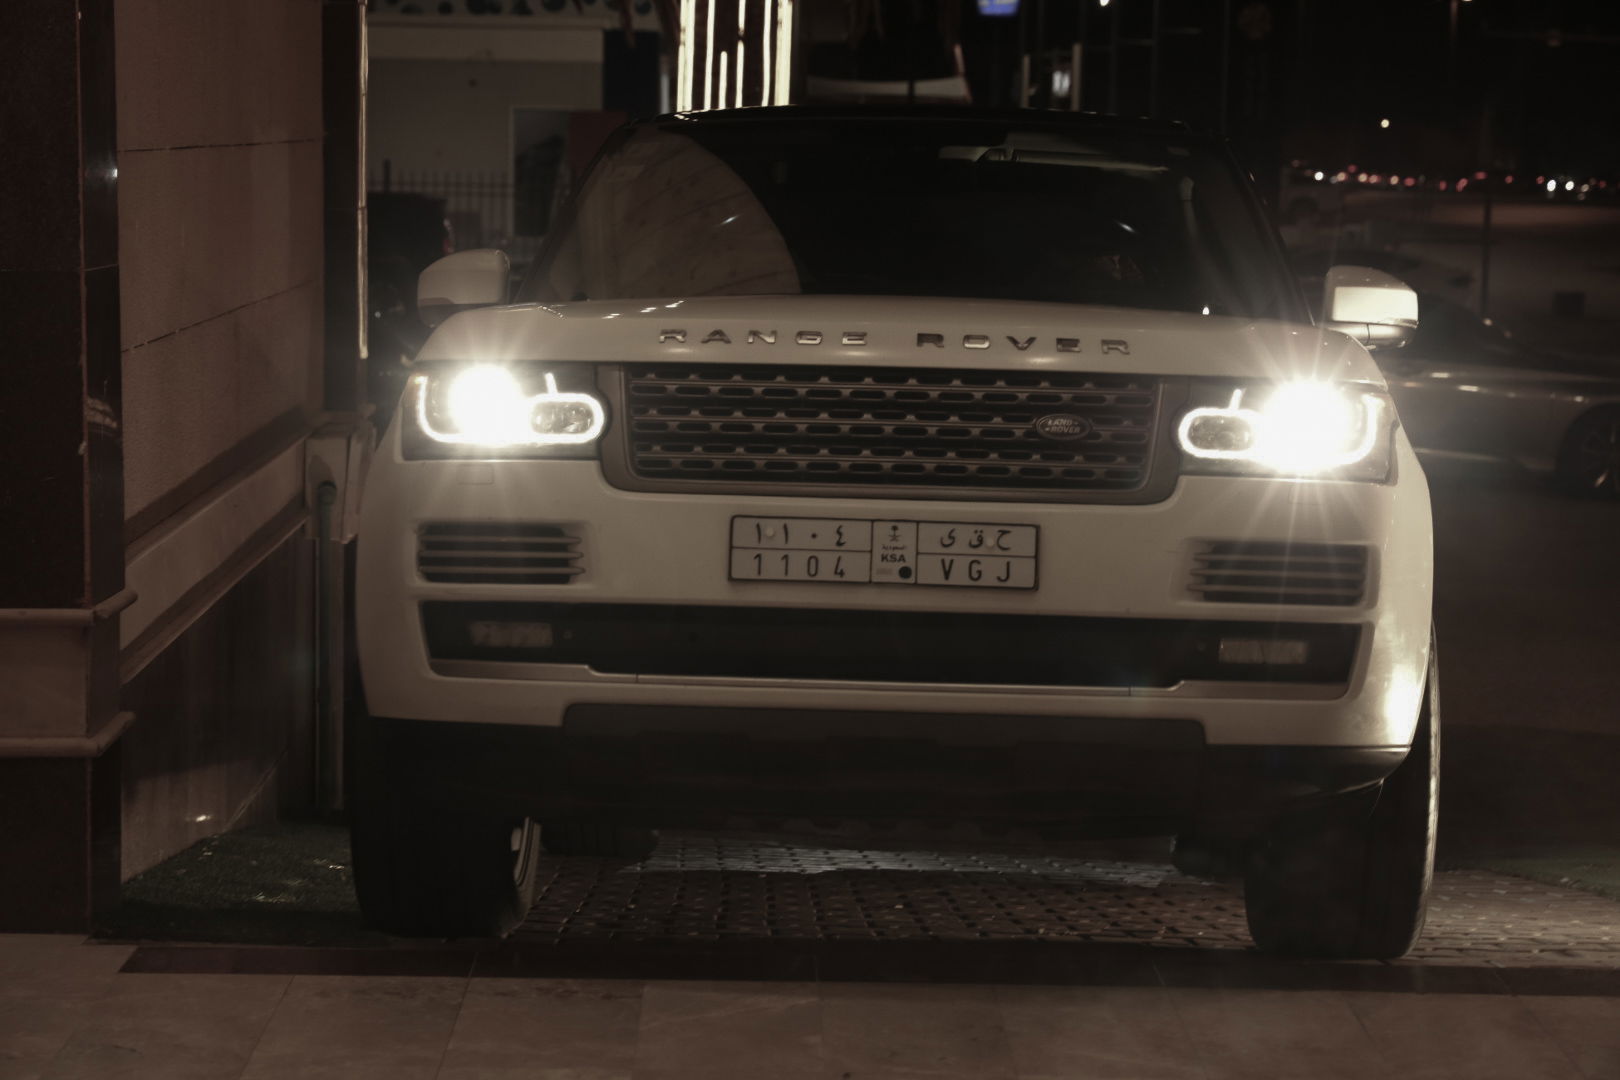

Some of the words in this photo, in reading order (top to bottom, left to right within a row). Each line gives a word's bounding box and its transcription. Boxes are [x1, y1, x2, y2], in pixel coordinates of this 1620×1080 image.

[659, 328, 868, 346] RANGE
[916, 332, 1131, 354] ROVER
[752, 552, 846, 578] 1104
[880, 553, 906, 563] KSA
